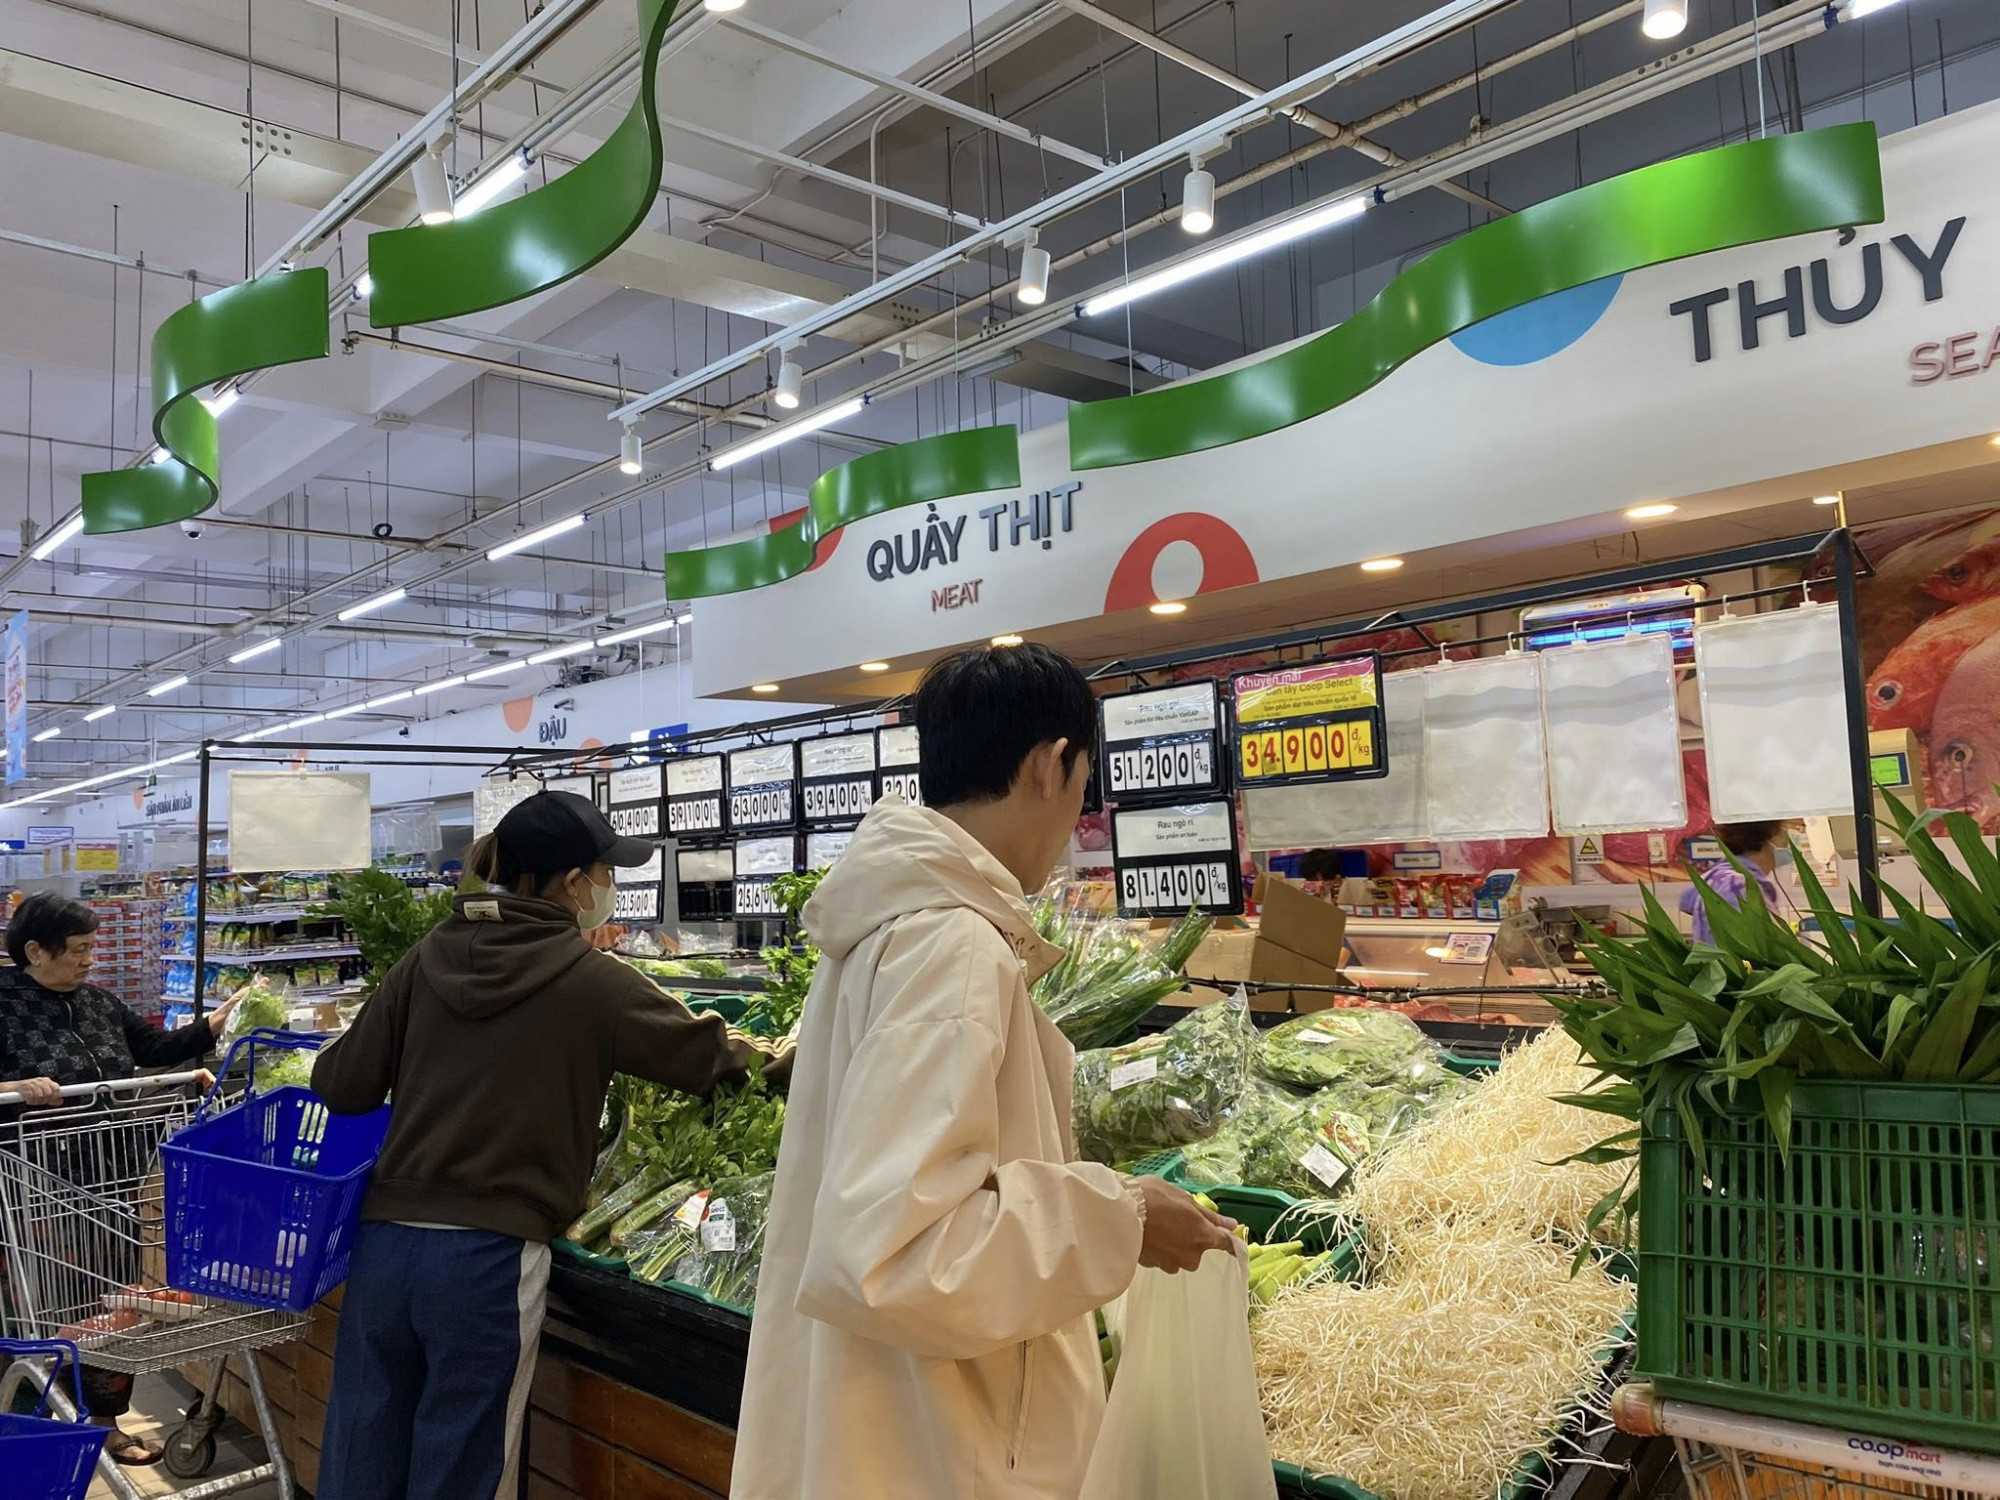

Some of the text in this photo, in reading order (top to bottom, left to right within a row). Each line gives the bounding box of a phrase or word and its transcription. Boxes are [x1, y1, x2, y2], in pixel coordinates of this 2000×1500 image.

[1670, 216, 1966, 363] THỦY
[867, 481, 1083, 582] QUẦY THỊT
[930, 578, 984, 612] MEAT
[1299, 682, 1323, 692] Coop
[1325, 678, 1353, 689] Select
[1246, 730, 1344, 768] 34.900
[1114, 752, 1189, 782] 51.200
[733, 793, 779, 817] 63.000
[807, 785, 859, 811] 39.400
[671, 802, 710, 825] 59.100
[1157, 820, 1171, 829] Rau
[1126, 869, 1206, 899] 81.400
